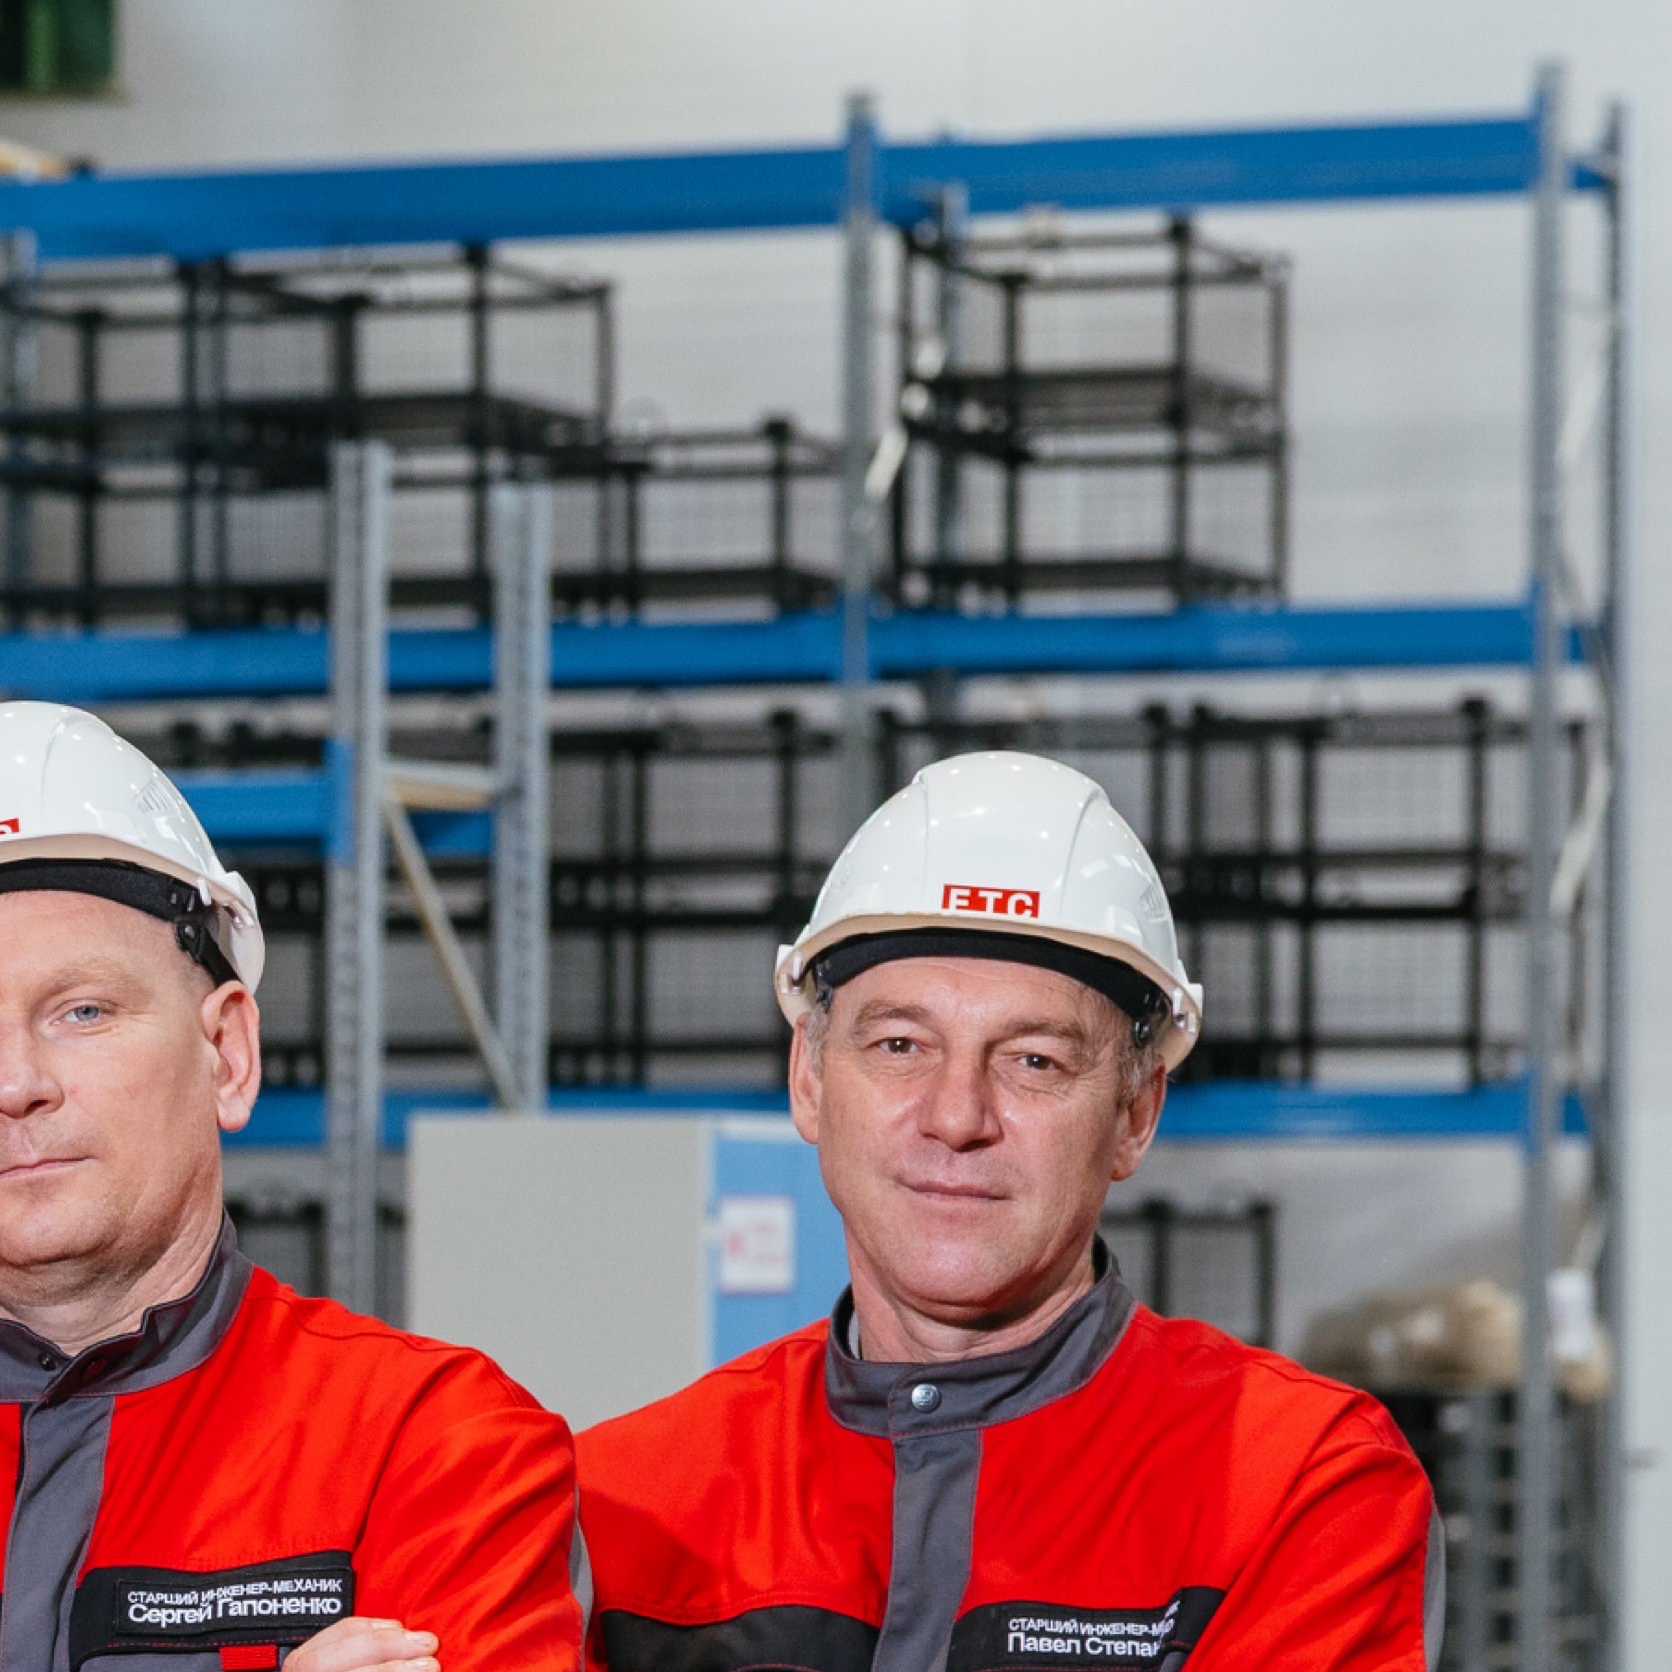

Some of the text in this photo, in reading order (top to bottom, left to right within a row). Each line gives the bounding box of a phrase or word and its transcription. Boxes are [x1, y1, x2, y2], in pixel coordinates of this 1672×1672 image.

[127, 1578, 343, 1606] СТАРШИЙ ИНЖЕНЕР-МЕХАНИК
[127, 1597, 343, 1628] Сергей Гапоненко
[1009, 1617, 1078, 1633] СТАРШИЙ
[1007, 1631, 1081, 1655] Павел
